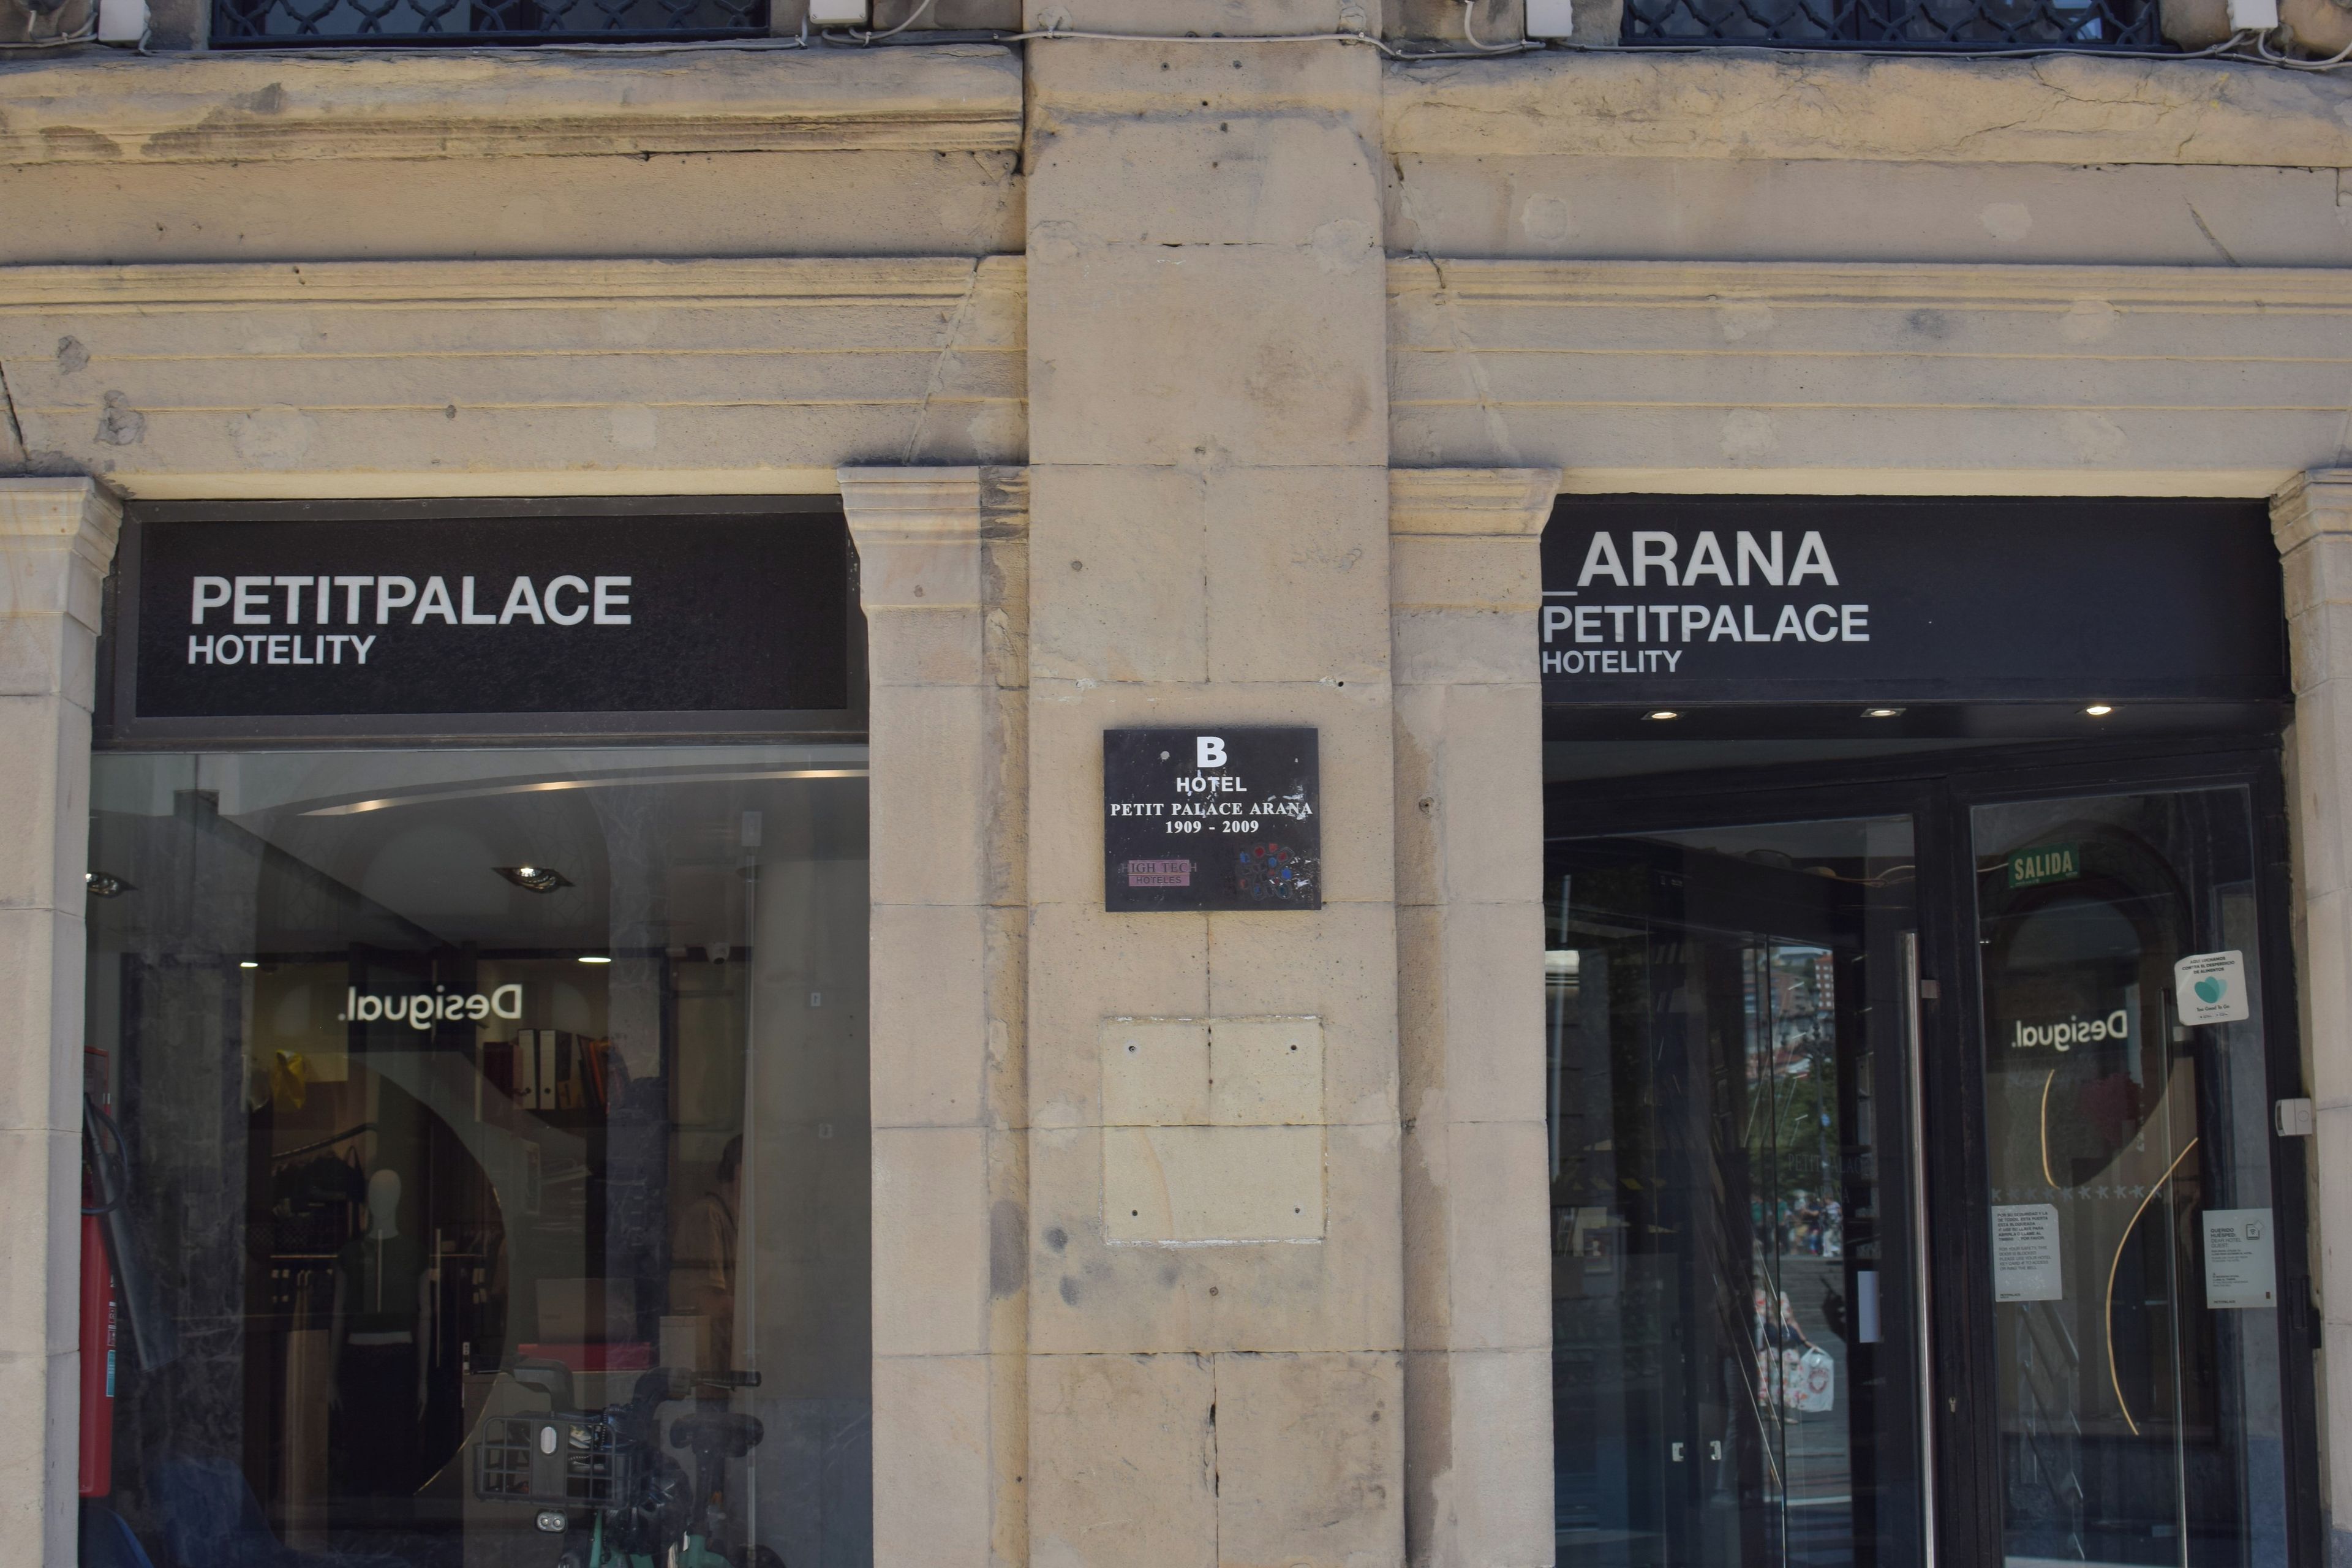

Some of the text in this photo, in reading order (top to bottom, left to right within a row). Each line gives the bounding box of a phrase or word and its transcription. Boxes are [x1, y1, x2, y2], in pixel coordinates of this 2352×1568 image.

[1577, 530, 1839, 587] ARANA
[191, 575, 632, 625] PETITPALACE
[1543, 603, 1870, 643] PETITPALACE
[187, 634, 376, 665] HOTELITY
[1542, 650, 1683, 673] HOTELITY
[1196, 736, 1227, 768] B
[1177, 777, 1247, 792] HOTEL
[1110, 802, 1313, 816] PETIT PALACE ARANA
[1166, 821, 1202, 834] 1909
[1222, 820, 1259, 834] 2009
[2015, 851, 2073, 881] SALIDA
